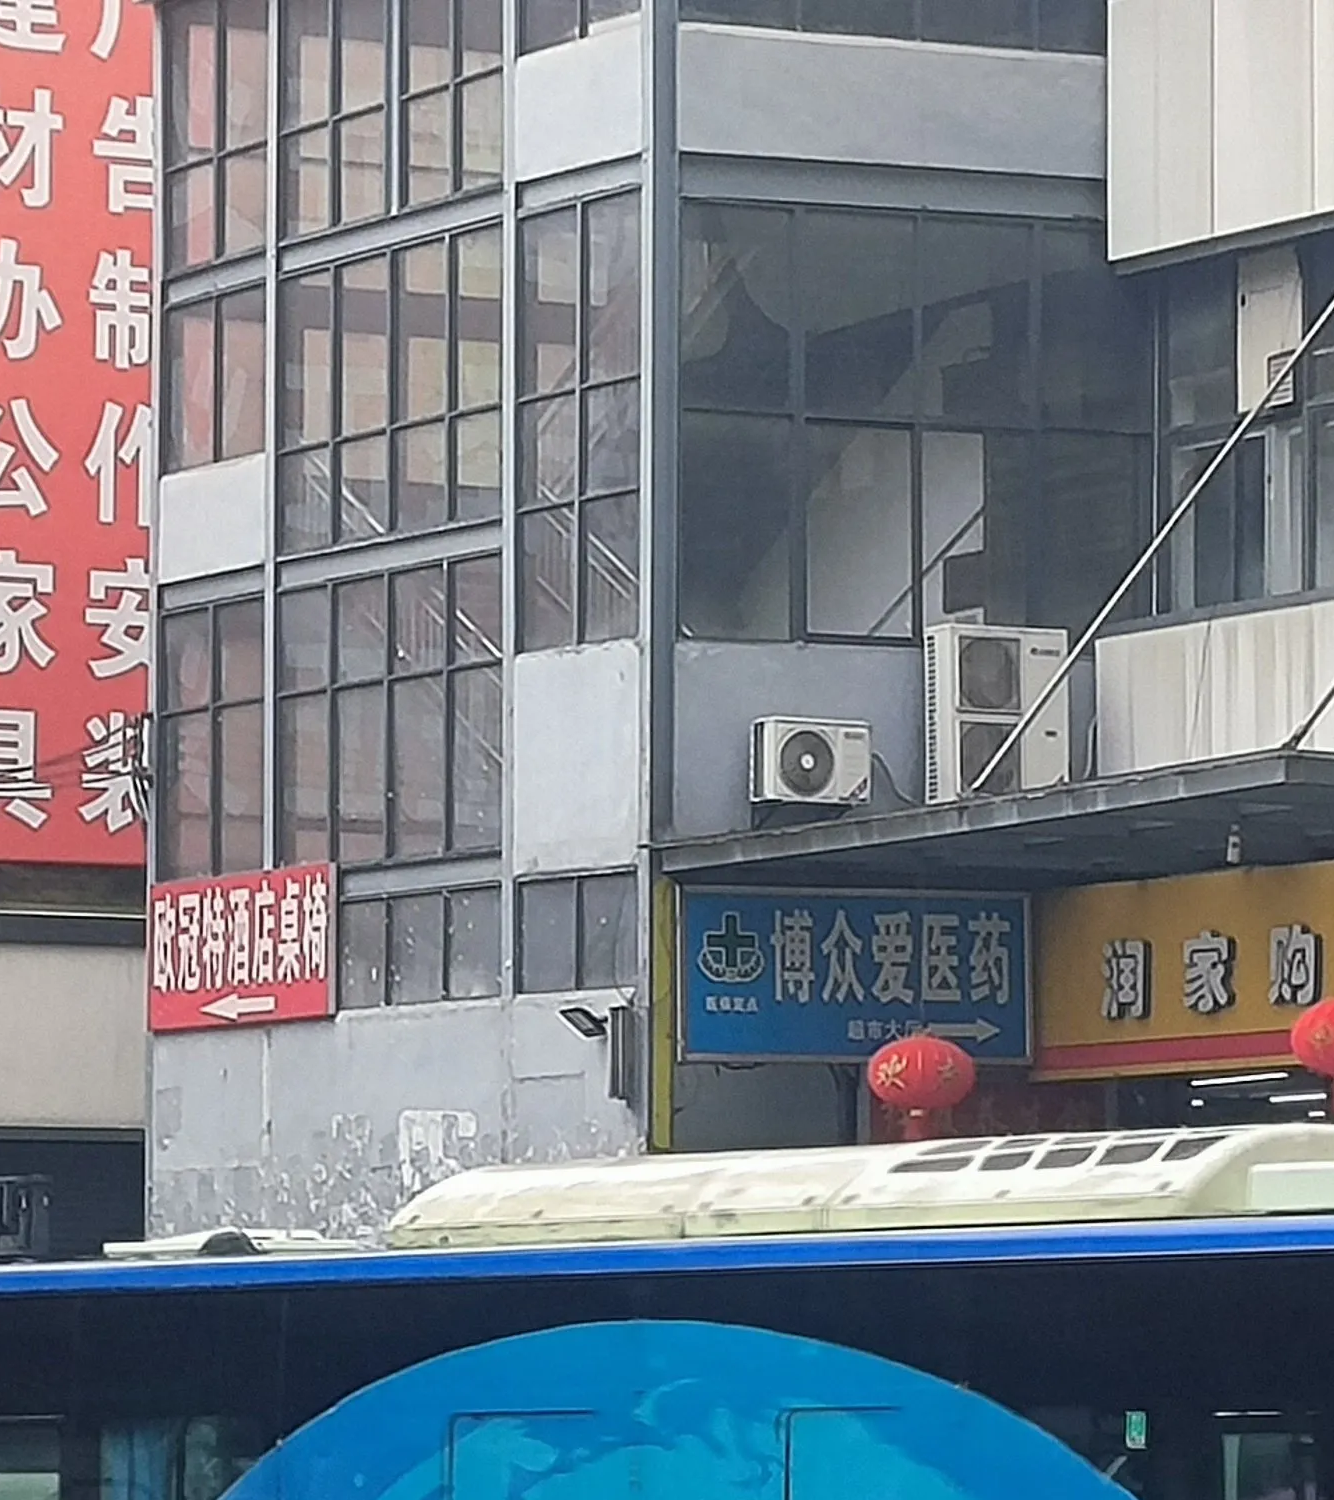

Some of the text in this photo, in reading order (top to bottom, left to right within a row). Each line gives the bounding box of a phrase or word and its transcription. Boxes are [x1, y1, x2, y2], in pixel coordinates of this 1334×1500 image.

[153, 871, 328, 994] 欧冠特酒店桌椅
[770, 908, 1012, 1006] 博众爱医药
